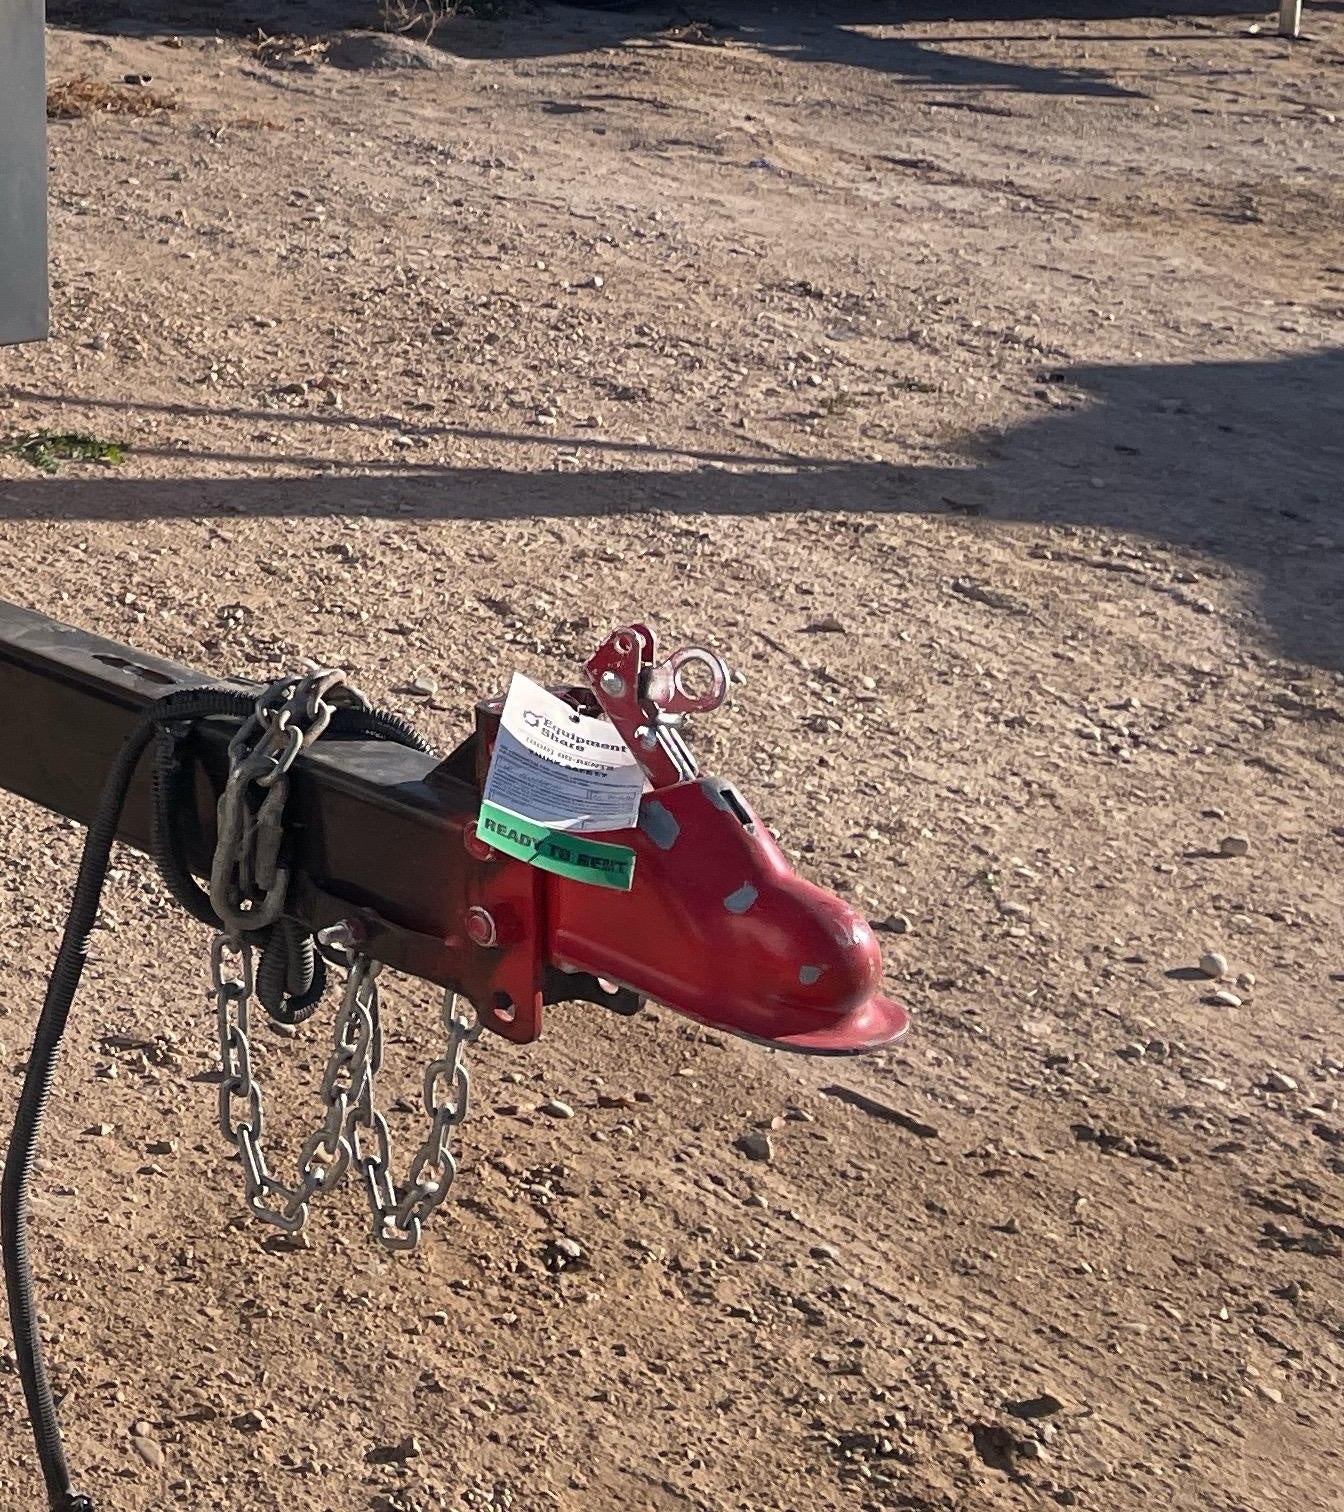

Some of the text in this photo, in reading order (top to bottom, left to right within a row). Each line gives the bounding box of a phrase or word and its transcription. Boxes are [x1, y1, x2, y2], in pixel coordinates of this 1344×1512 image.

[541, 727, 586, 753] Share
[543, 717, 629, 754] Equipment
[484, 817, 543, 851] READY
